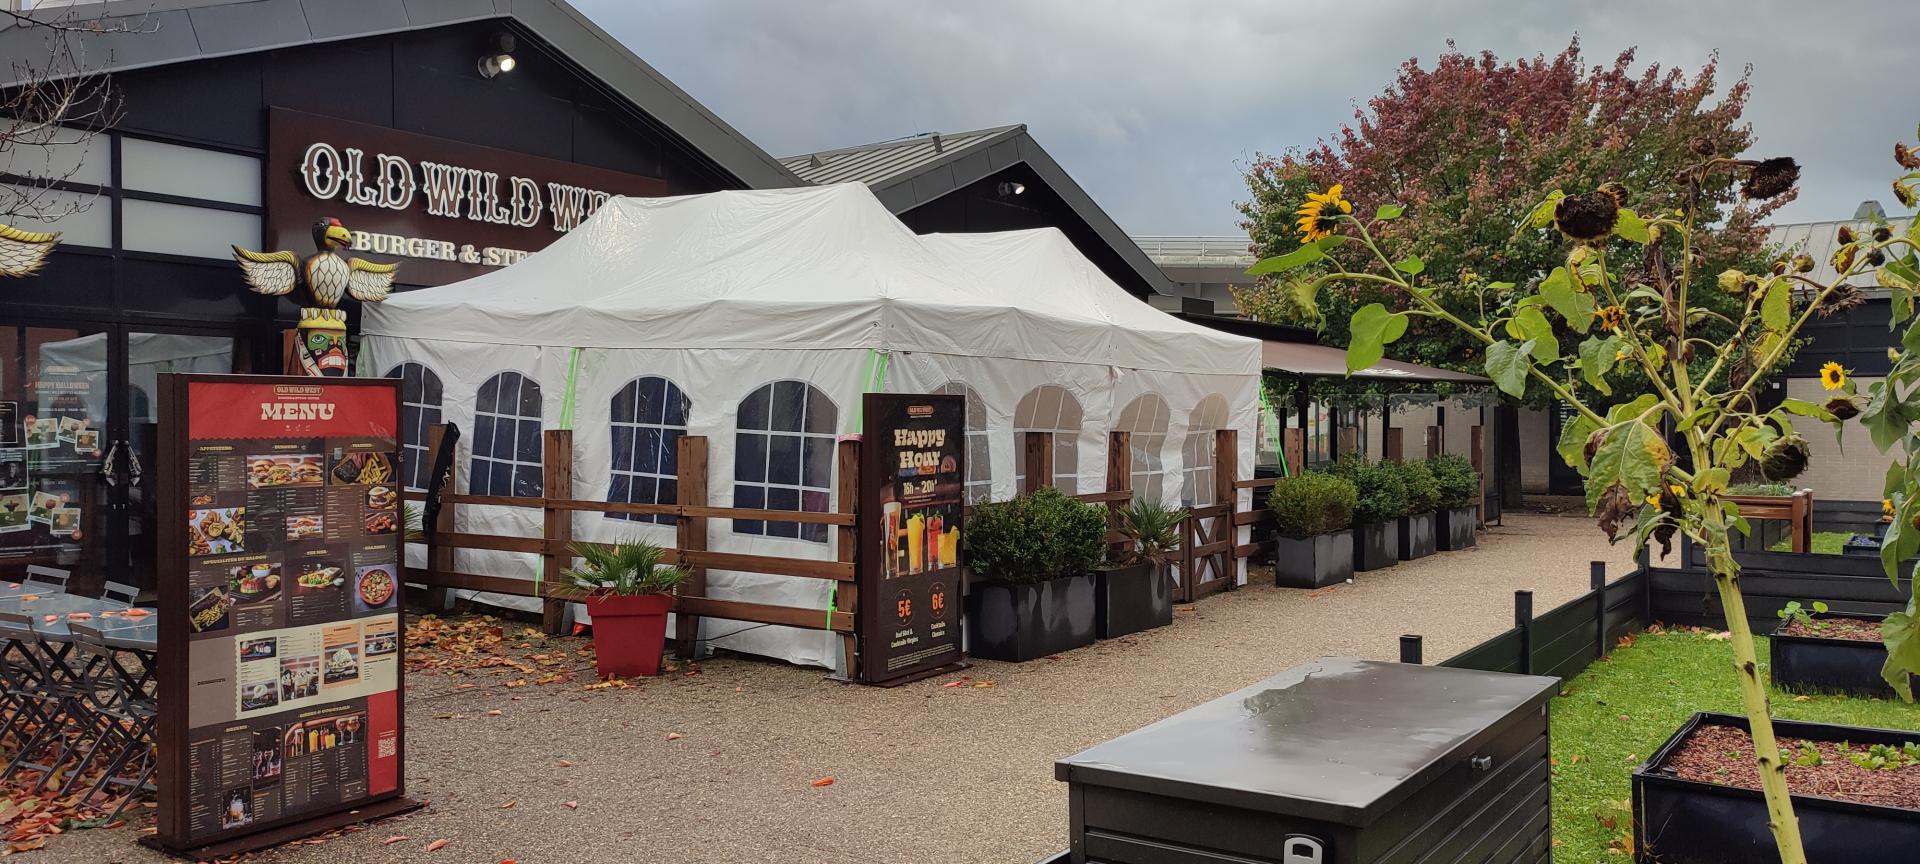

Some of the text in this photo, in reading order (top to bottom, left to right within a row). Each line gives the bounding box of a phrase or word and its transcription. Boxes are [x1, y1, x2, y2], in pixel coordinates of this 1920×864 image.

[301, 142, 626, 232] OLD WILD WE
[351, 230, 457, 262] BURGER
[458, 244, 481, 264] &
[289, 386, 305, 394] WILD
[261, 402, 336, 421] MENU
[894, 429, 946, 448] Happy
[899, 451, 940, 469] Hour
[903, 482, 914, 495] 16h
[898, 599, 912, 617] 5€
[932, 592, 944, 610] 6€
